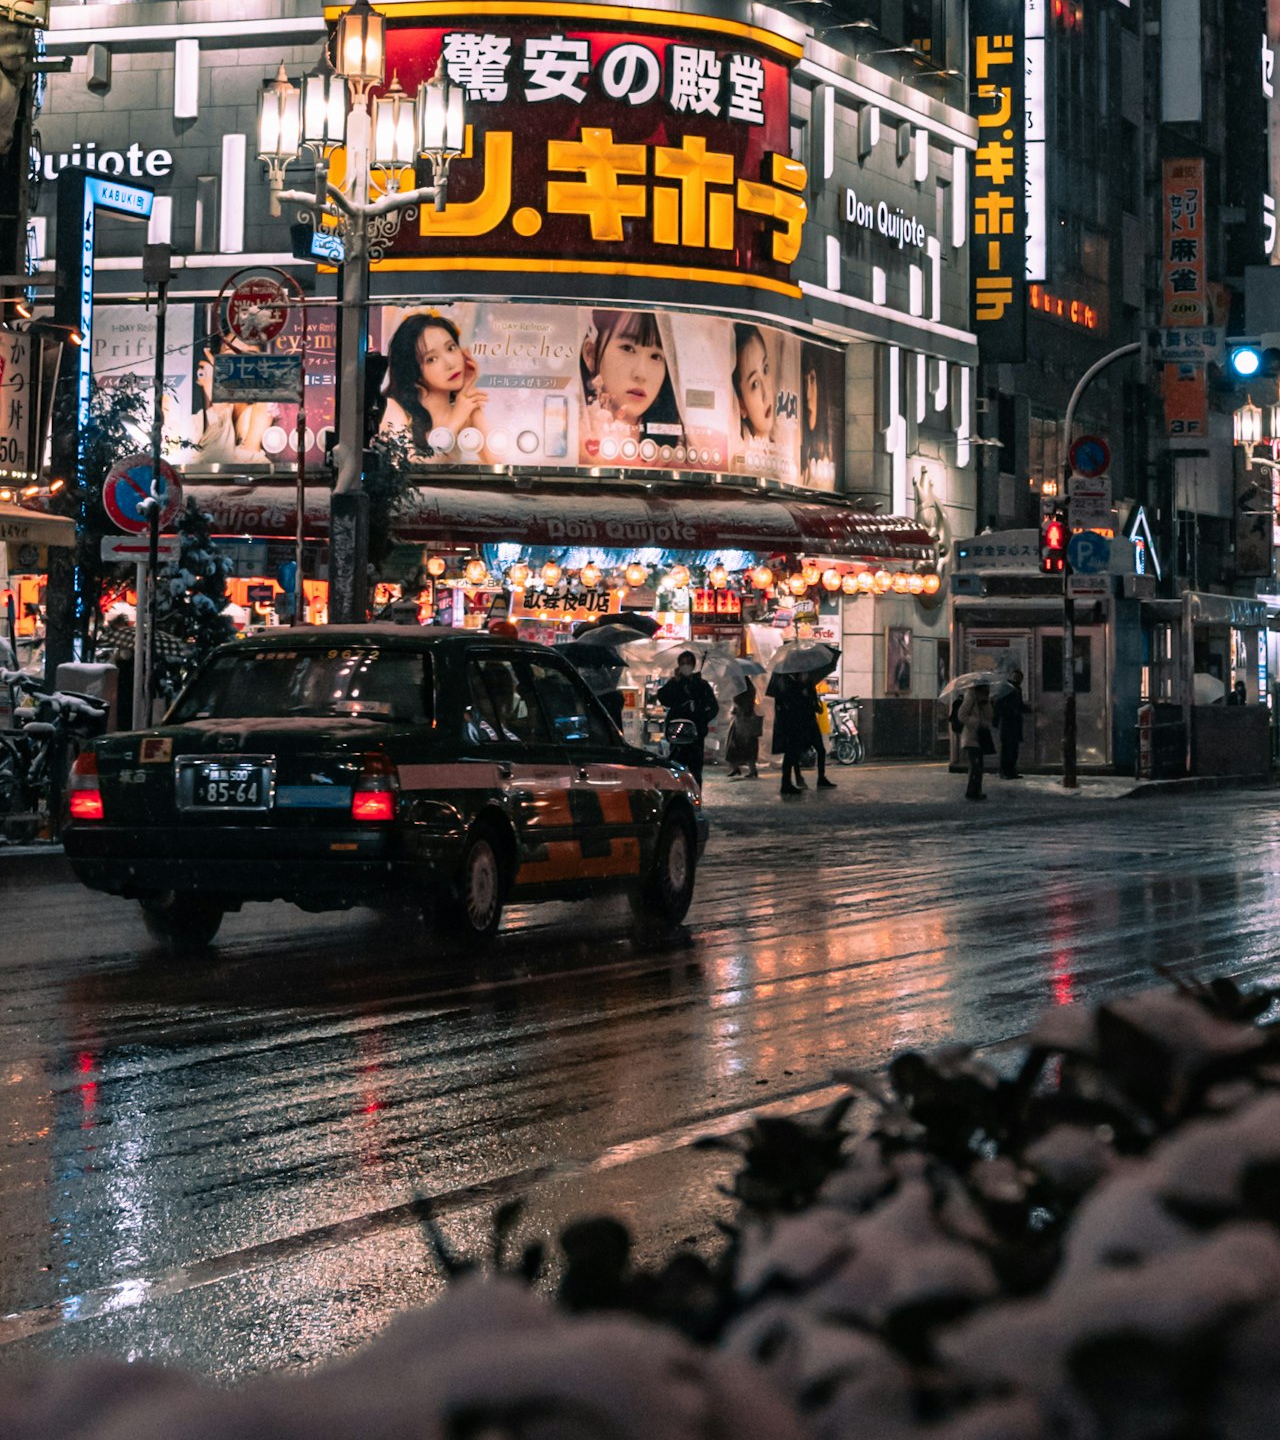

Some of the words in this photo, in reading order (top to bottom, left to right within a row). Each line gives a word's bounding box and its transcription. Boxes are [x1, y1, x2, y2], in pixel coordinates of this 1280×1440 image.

[442, 33, 765, 127] 驚安の殿堂
[846, 188, 874, 228] Don
[876, 200, 926, 248] Quijote
[1170, 195, 1182, 232] セット
[1185, 189, 1198, 229] フリー
[1170, 238, 1197, 292] 麻雀
[7, 337, 25, 430] かつ丼
[1170, 420, 1199, 433] 3F
[207, 783, 257, 803] 85-64
